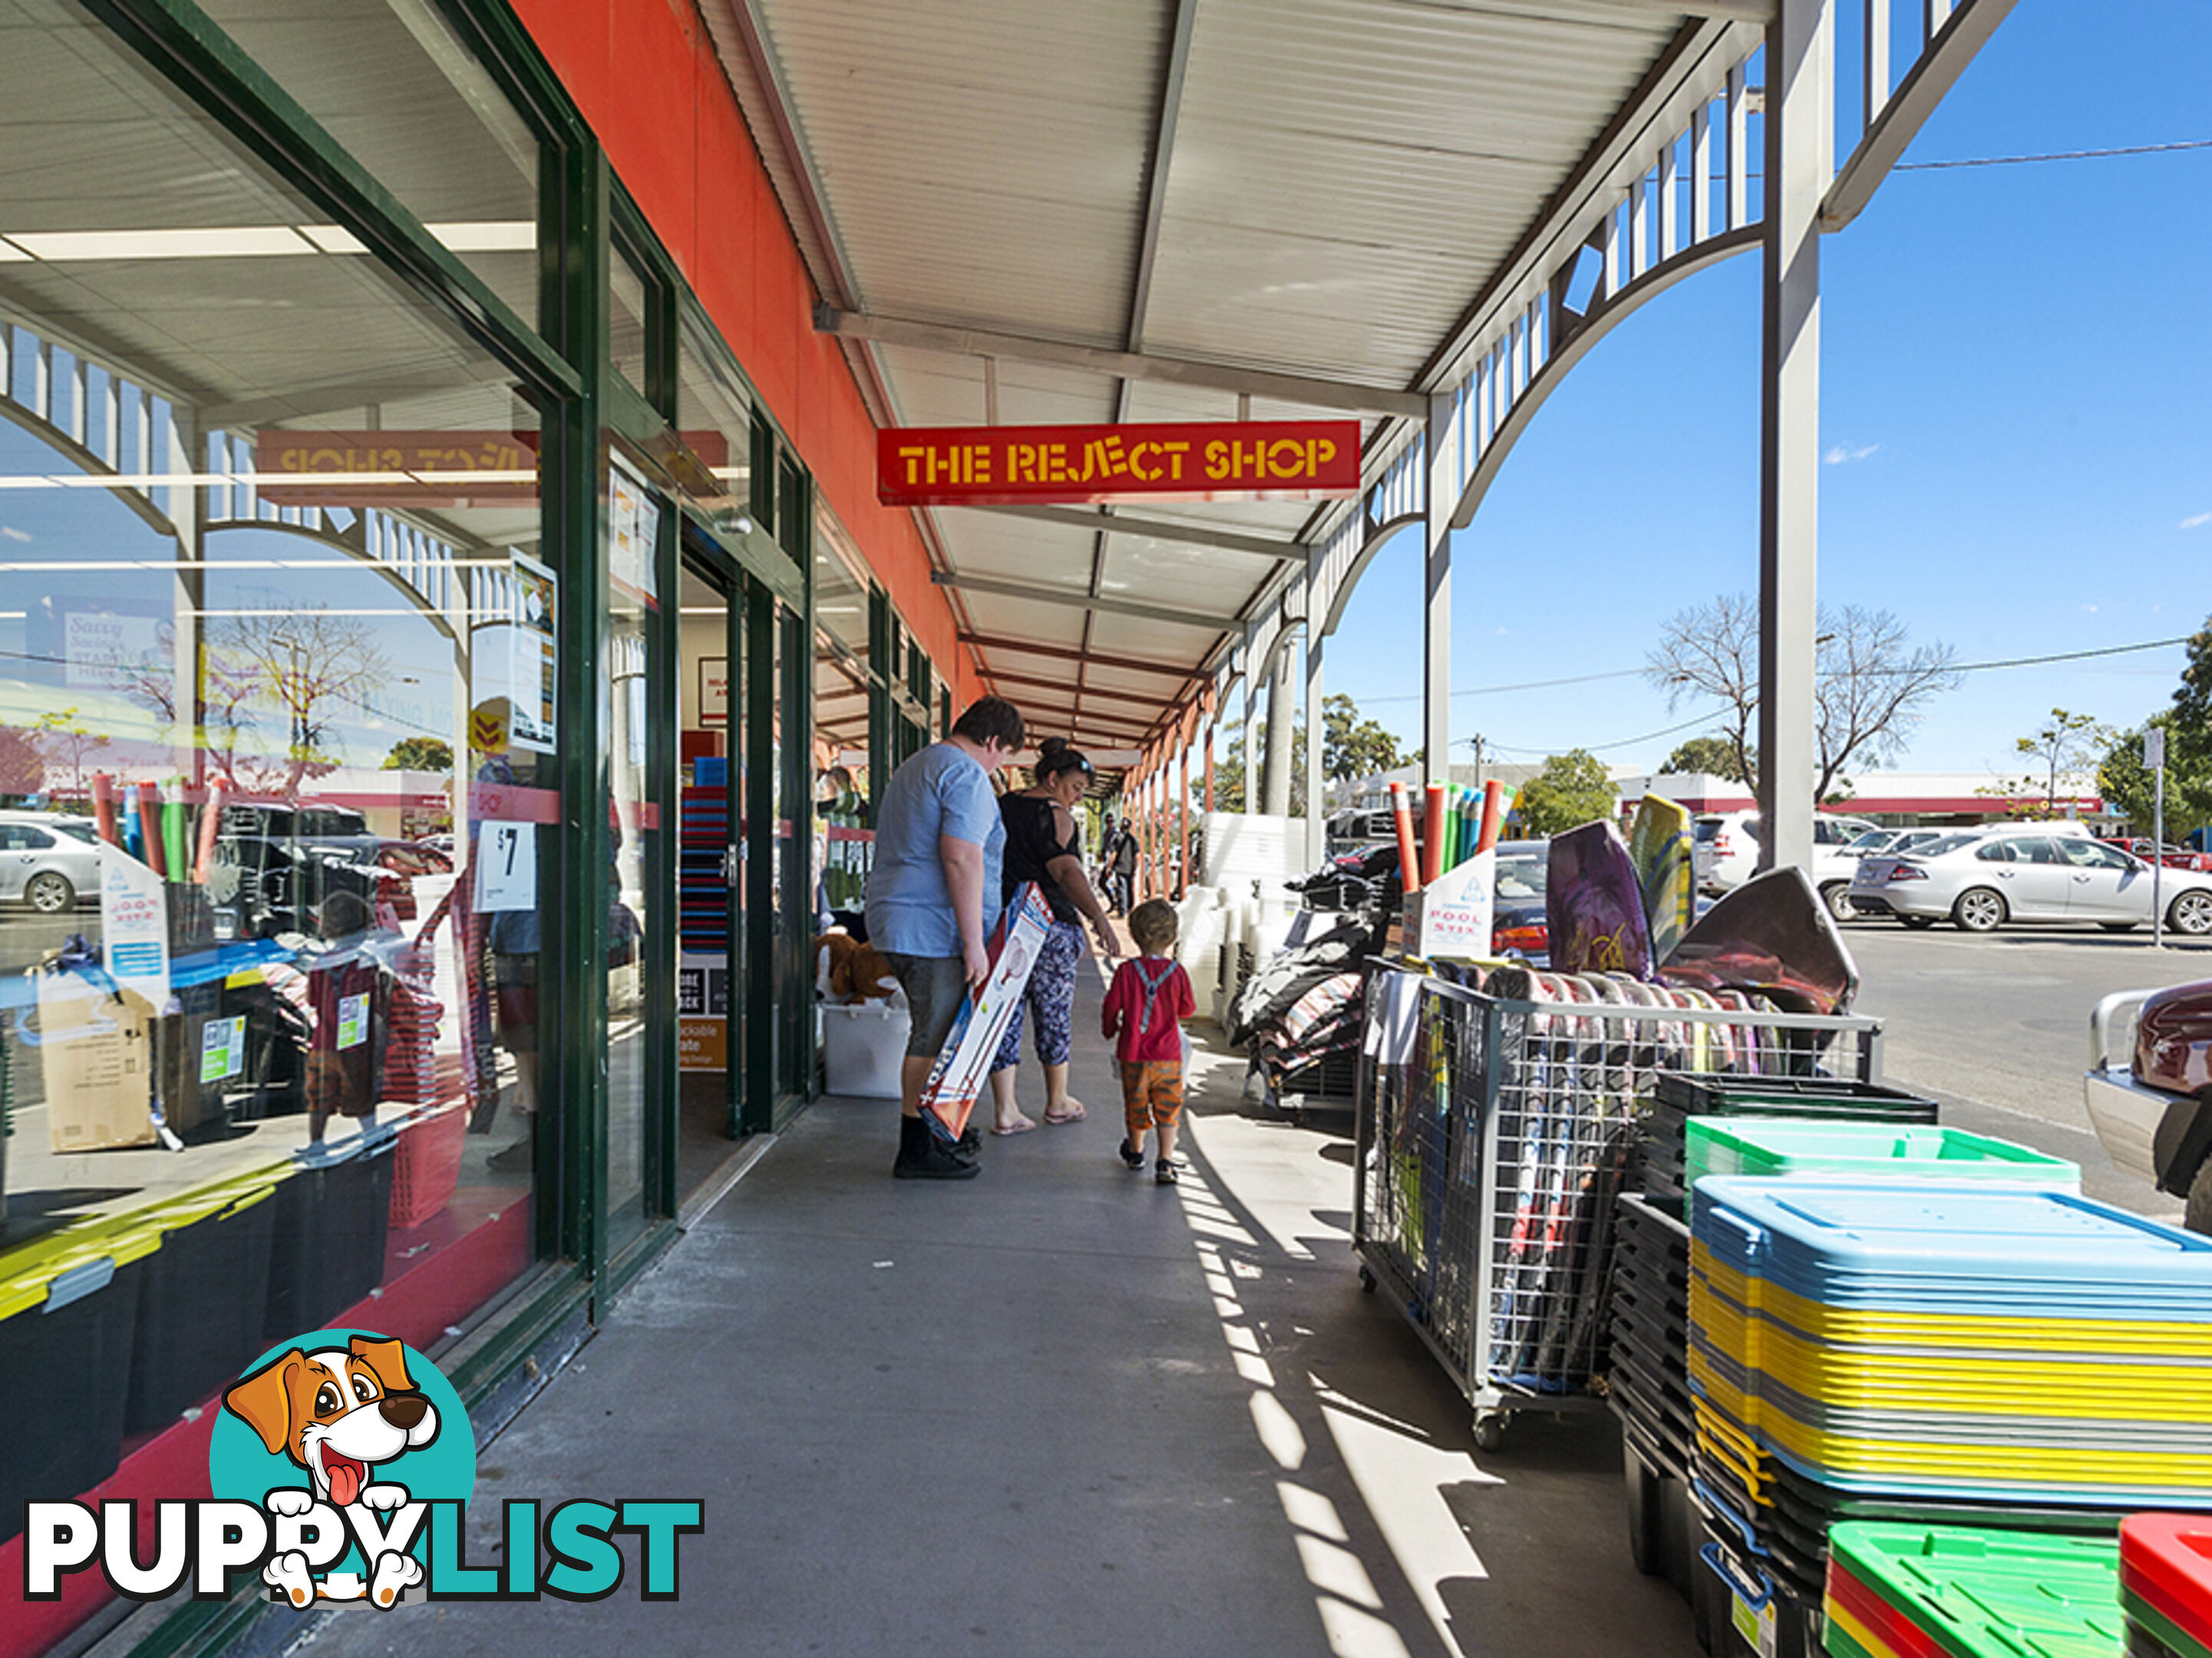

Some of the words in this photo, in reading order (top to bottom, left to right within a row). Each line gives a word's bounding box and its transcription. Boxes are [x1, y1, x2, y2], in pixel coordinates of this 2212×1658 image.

[899, 445, 990, 484] THE
[1007, 435, 1190, 482] REJECT
[1205, 439, 1337, 481] SHOP
[497, 827, 517, 877] $7
[1431, 910, 1481, 925] POOL
[1434, 922, 1474, 934] STIX
